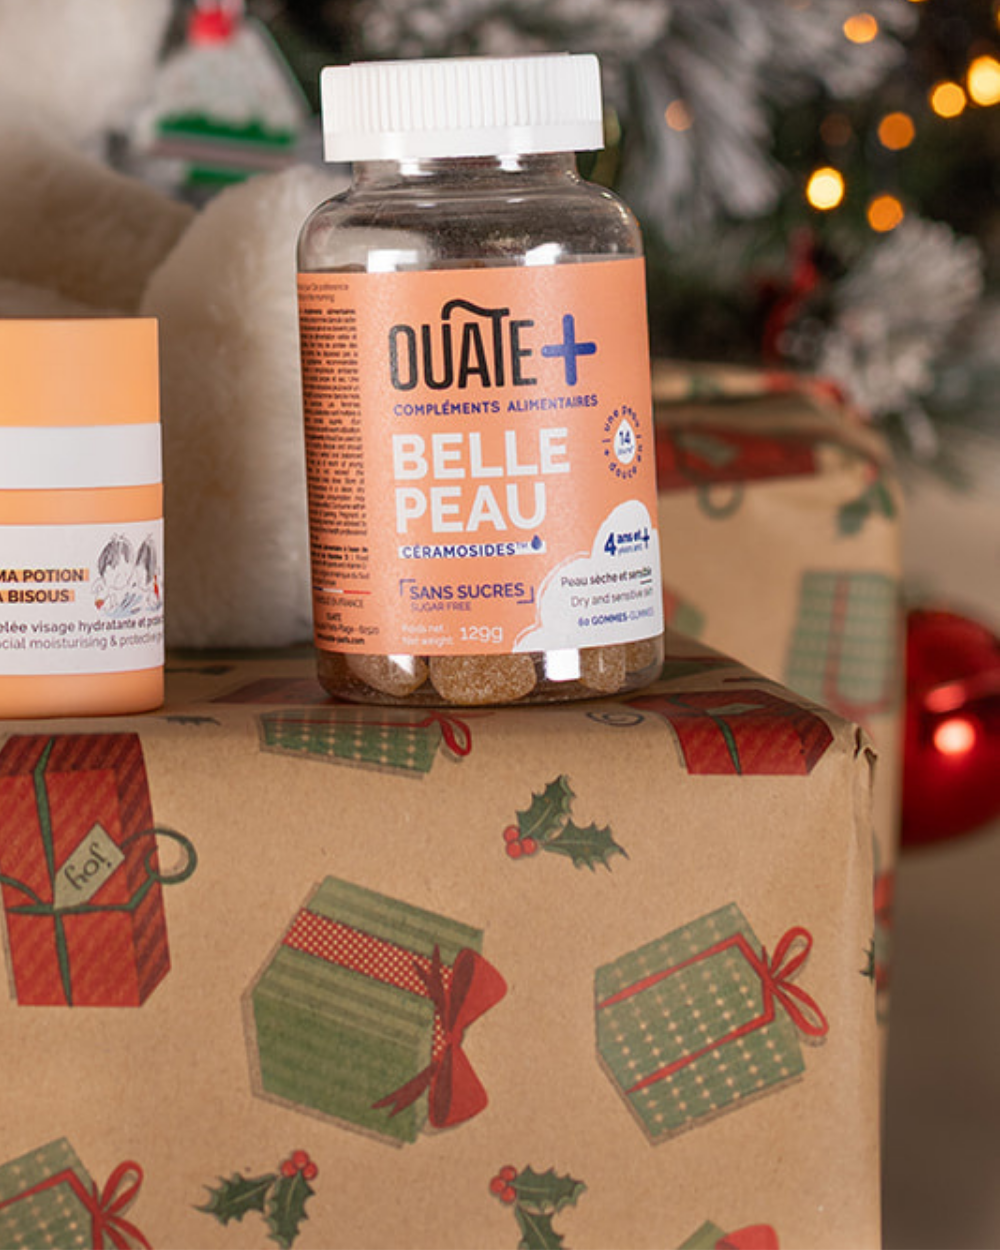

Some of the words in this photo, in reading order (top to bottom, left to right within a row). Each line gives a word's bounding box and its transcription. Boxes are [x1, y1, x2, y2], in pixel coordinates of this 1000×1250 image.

[393, 399, 501, 417] COMPLÉMENTS
[506, 394, 599, 413] ALIMENTAIRES
[391, 427, 571, 480] BELLE
[394, 482, 546, 534] PEAU
[604, 532, 617, 556] 4
[22, 568, 84, 583] POTION
[561, 576, 589, 587] Peau
[7, 588, 70, 603] BISOUS
[409, 584, 454, 601] SANS
[457, 582, 525, 600] SUCRES
[570, 595, 590, 608] Dry
[591, 593, 610, 605] and
[410, 602, 444, 612] SUGAR
[446, 601, 472, 611] FREE
[30, 620, 76, 636] visage
[77, 617, 137, 635] hydratante
[459, 626, 503, 644] 129g
[29, 635, 108, 651] moisturising
[109, 634, 118, 648] &
